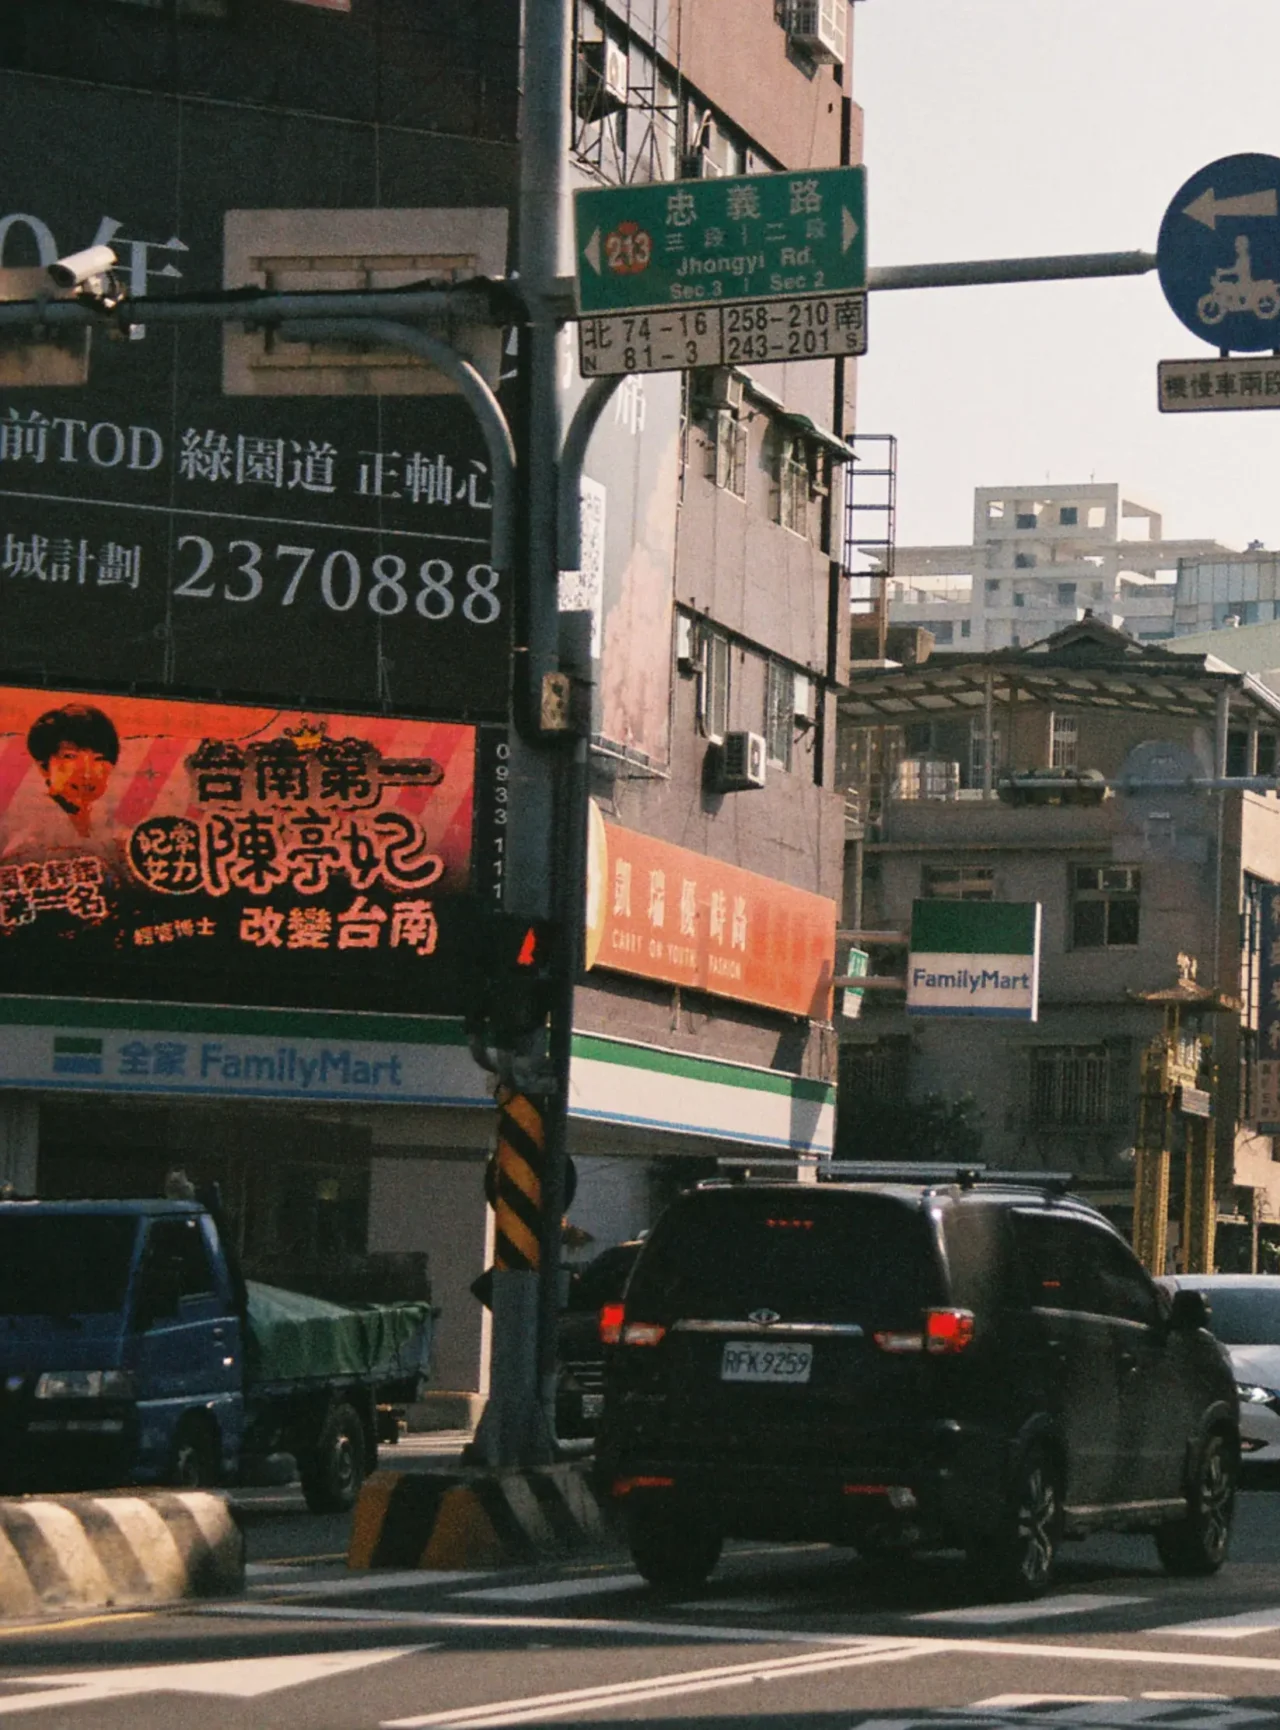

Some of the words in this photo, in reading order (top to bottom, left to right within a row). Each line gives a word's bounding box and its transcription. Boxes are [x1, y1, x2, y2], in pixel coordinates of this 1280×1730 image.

[665, 179, 822, 226] 忠義路
[607, 233, 650, 267] 213
[665, 226, 724, 251] 三段
[765, 218, 827, 241] 二段
[677, 252, 766, 277] Jhongyi
[727, 302, 829, 333] 258-210
[834, 302, 862, 331] 南
[585, 318, 612, 350] 北
[727, 332, 830, 360] 243-201
[845, 332, 858, 348] S
[585, 356, 598, 371] N
[180, 427, 338, 495] 綠園道
[357, 450, 494, 509] 正軸心
[2, 534, 142, 589] 城計劃
[173, 534, 501, 624] 2370888
[198, 740, 440, 804] 台南第一
[205, 810, 443, 892] 陳亭妃
[239, 897, 438, 955] 改變台南
[912, 967, 1029, 993] FamilyMart
[118, 1040, 187, 1077] 全家
[199, 1043, 403, 1088] FamilyMart
